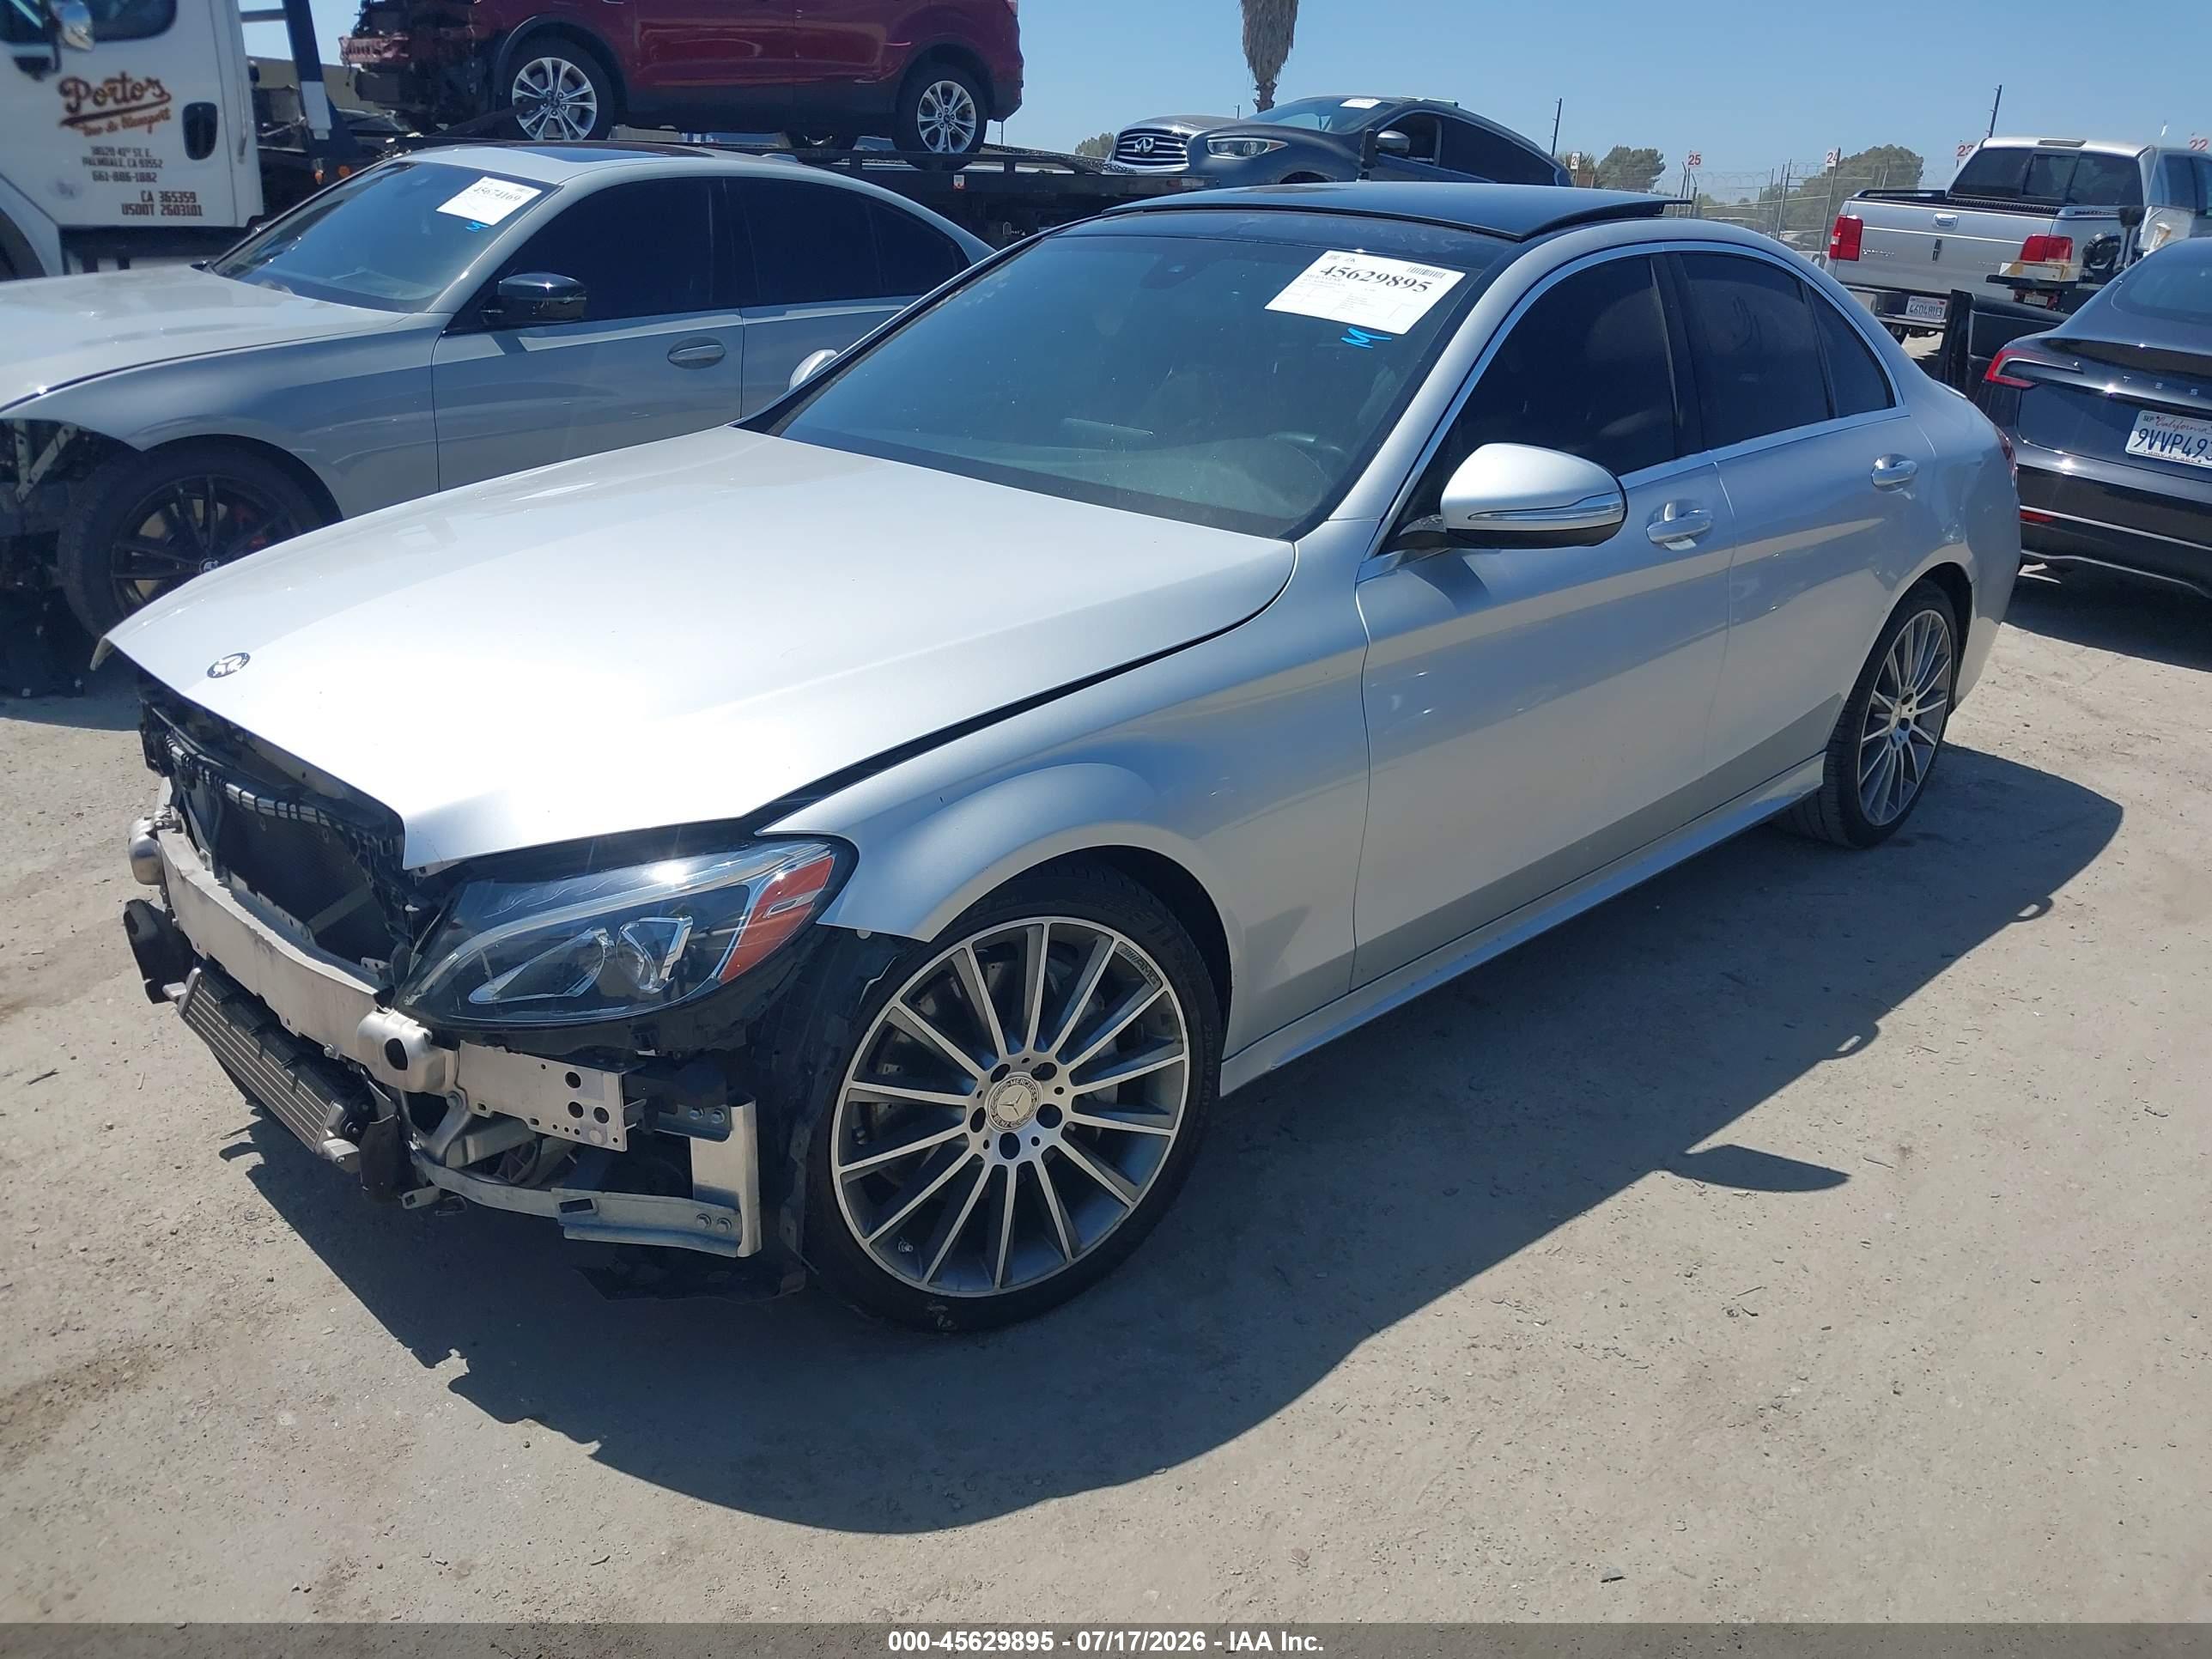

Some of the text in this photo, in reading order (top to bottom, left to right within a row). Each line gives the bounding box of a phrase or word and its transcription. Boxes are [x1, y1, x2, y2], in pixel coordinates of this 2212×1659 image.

[1688, 154, 1701, 166] 25
[140, 190, 155, 203] CA
[121, 203, 155, 216] USDOT
[1320, 264, 1433, 293] 45629895
[2155, 416, 2208, 433] California
[2134, 428, 2212, 461] 9VVP49
